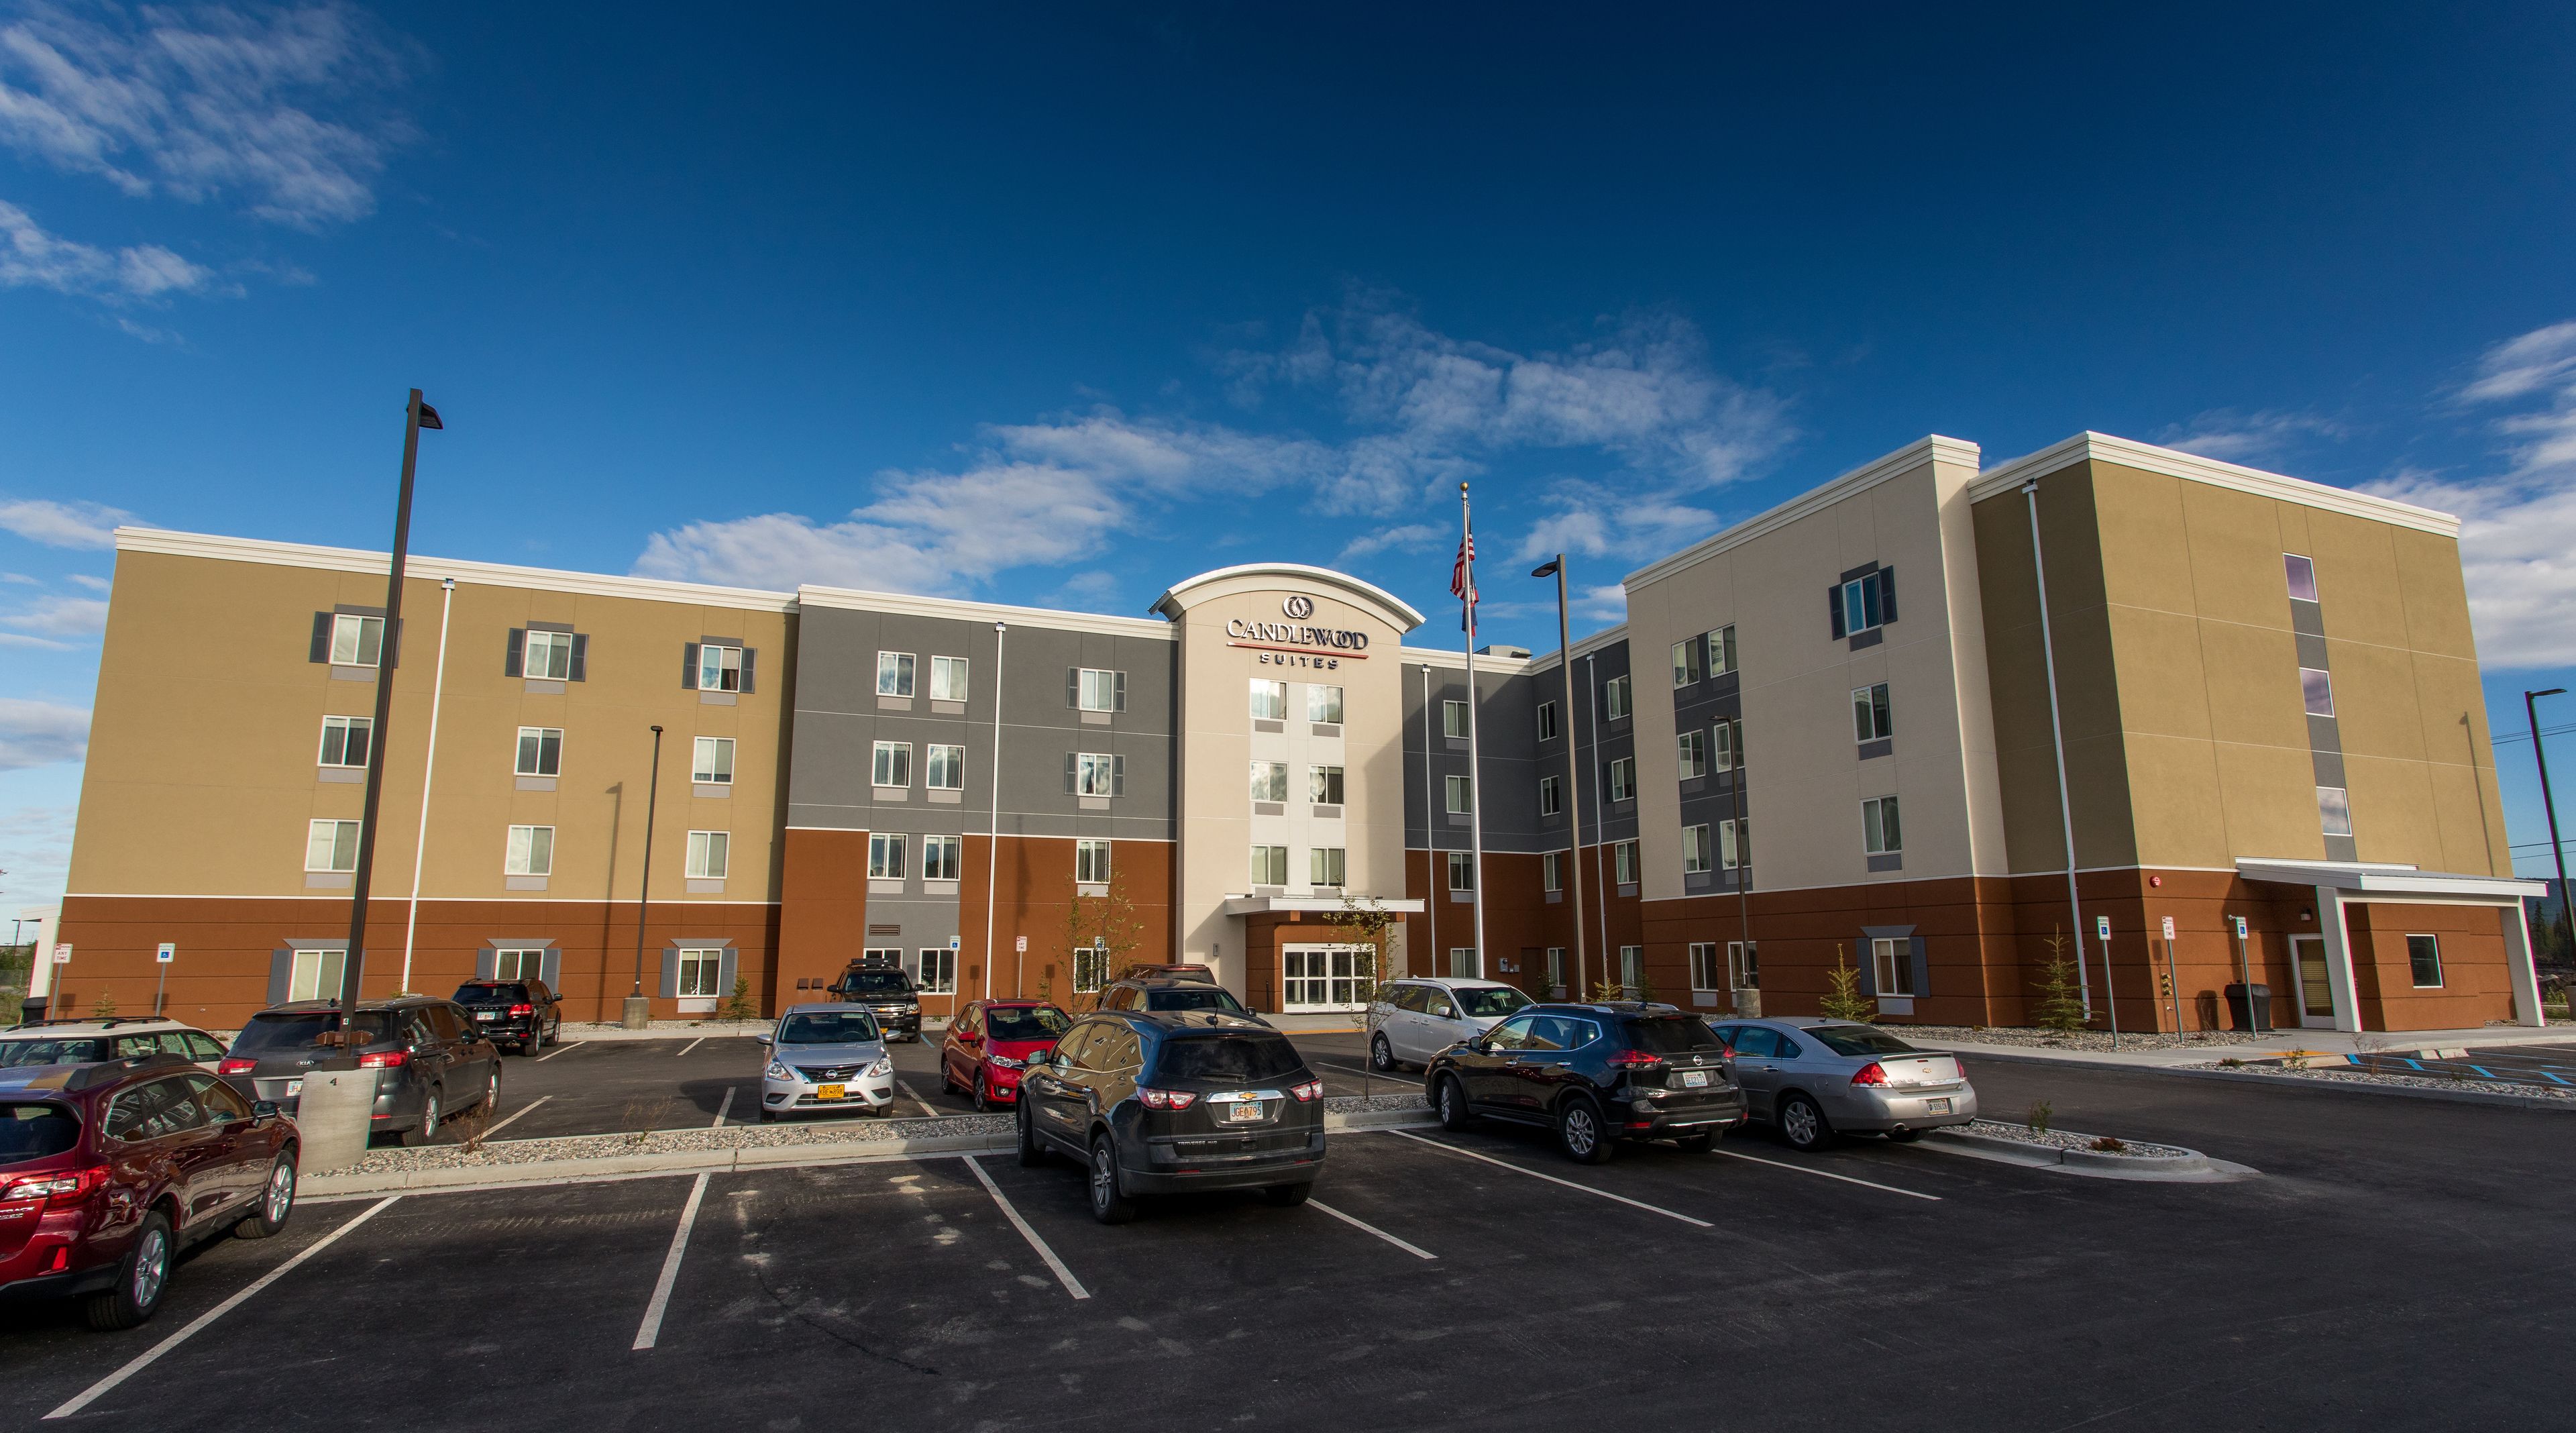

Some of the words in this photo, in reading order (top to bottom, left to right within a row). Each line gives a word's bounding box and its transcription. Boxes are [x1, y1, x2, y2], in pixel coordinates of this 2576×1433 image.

[1227, 619, 1368, 649] CANDLEWOOD
[1260, 653, 1338, 669] SUITES
[330, 1077, 337, 1085] 4
